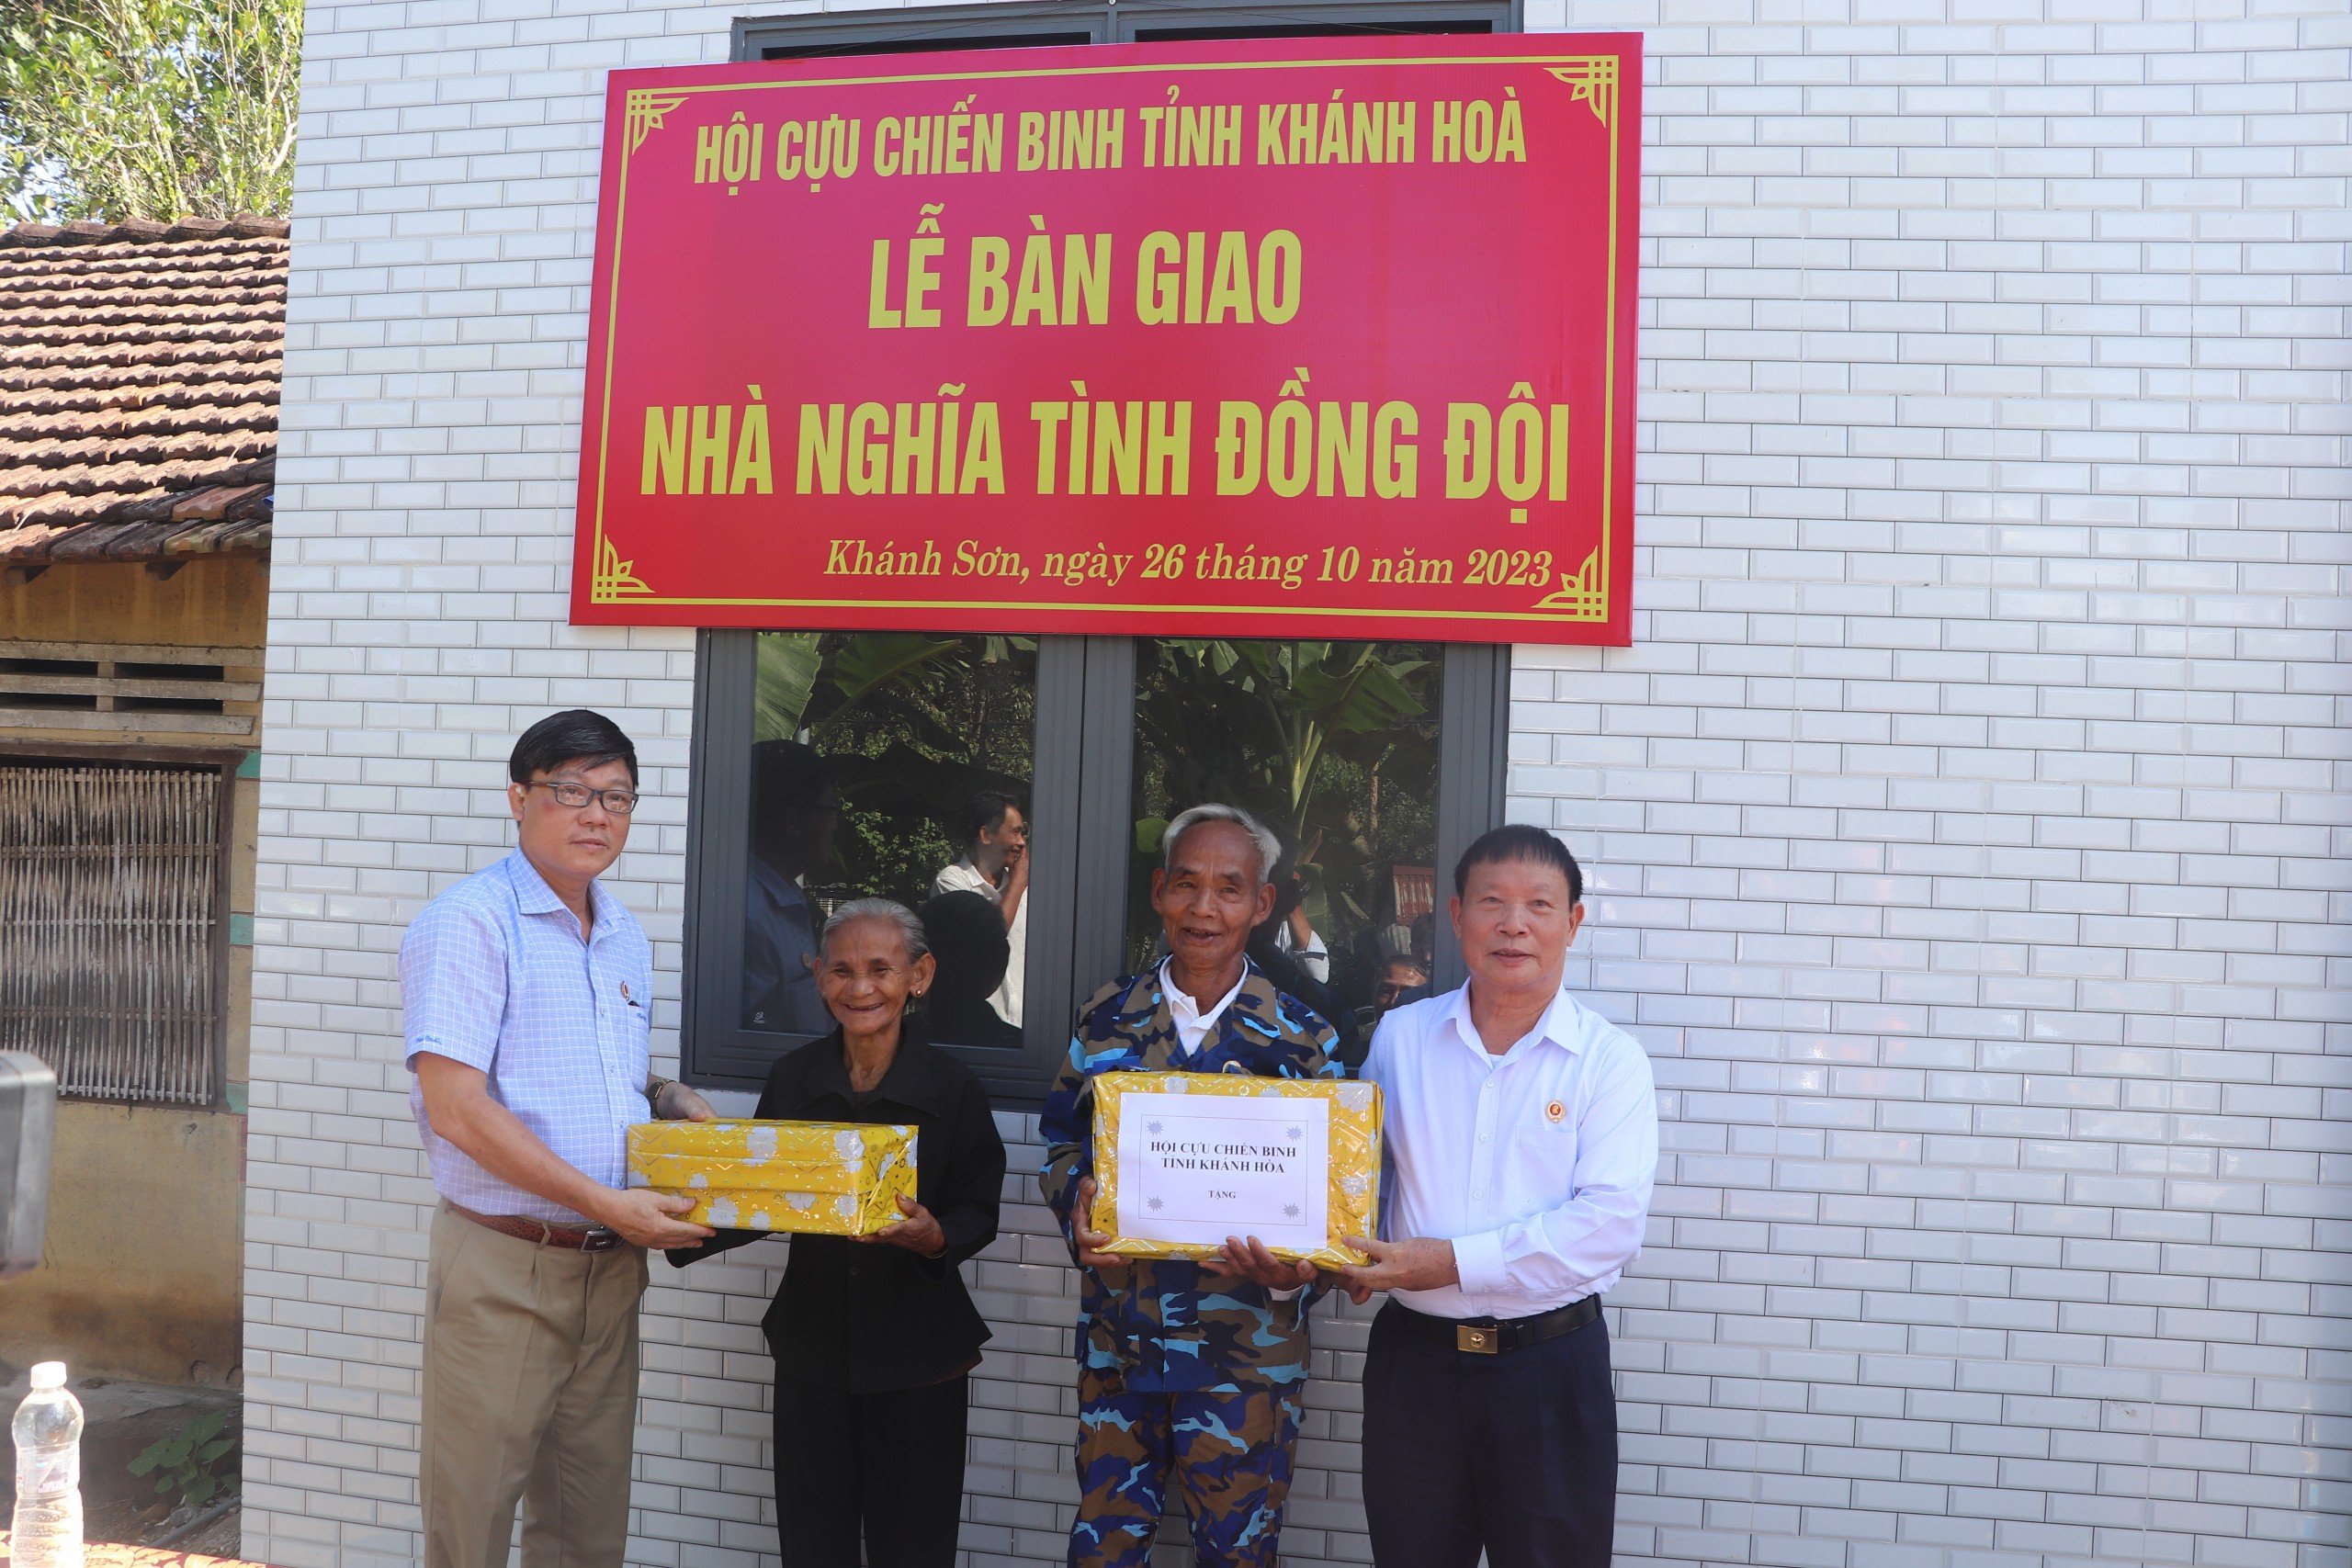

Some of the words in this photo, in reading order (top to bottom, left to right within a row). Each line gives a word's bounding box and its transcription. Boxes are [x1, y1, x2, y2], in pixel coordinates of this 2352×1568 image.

[695, 112, 763, 196] HỘI
[776, 110, 861, 193] CỰU
[874, 95, 1004, 176] CHIẾN
[1017, 108, 1125, 172] BINH
[1139, 85, 1242, 167] TỈNH
[1258, 89, 1416, 165] KHÁNH
[1432, 85, 1527, 164] HOÀ
[868, 203, 945, 329] LỄ
[967, 214, 1113, 327] BÀN
[1136, 229, 1302, 325] GIAO
[640, 384, 774, 495] NHÀ
[796, 382, 1006, 496] NGHĨA
[1030, 379, 1193, 496] TÌNH
[1215, 367, 1419, 500] ĐỒNG
[1443, 381, 1569, 524] ĐỘI
[824, 539, 942, 577] Khánh
[952, 541, 1030, 581] Sơn,
[1039, 542, 1133, 587] ngày
[1140, 543, 1187, 580] 26
[1195, 543, 1309, 589] tháng
[1318, 546, 1360, 582] 10
[1370, 547, 1453, 585] năm
[1464, 548, 1553, 587] 2023
[1181, 1142, 1211, 1156] CỰU
[1261, 1145, 1297, 1157] BINH
[1200, 1156, 1250, 1171] KHÁNH
[1254, 1159, 1285, 1173] HÒA
